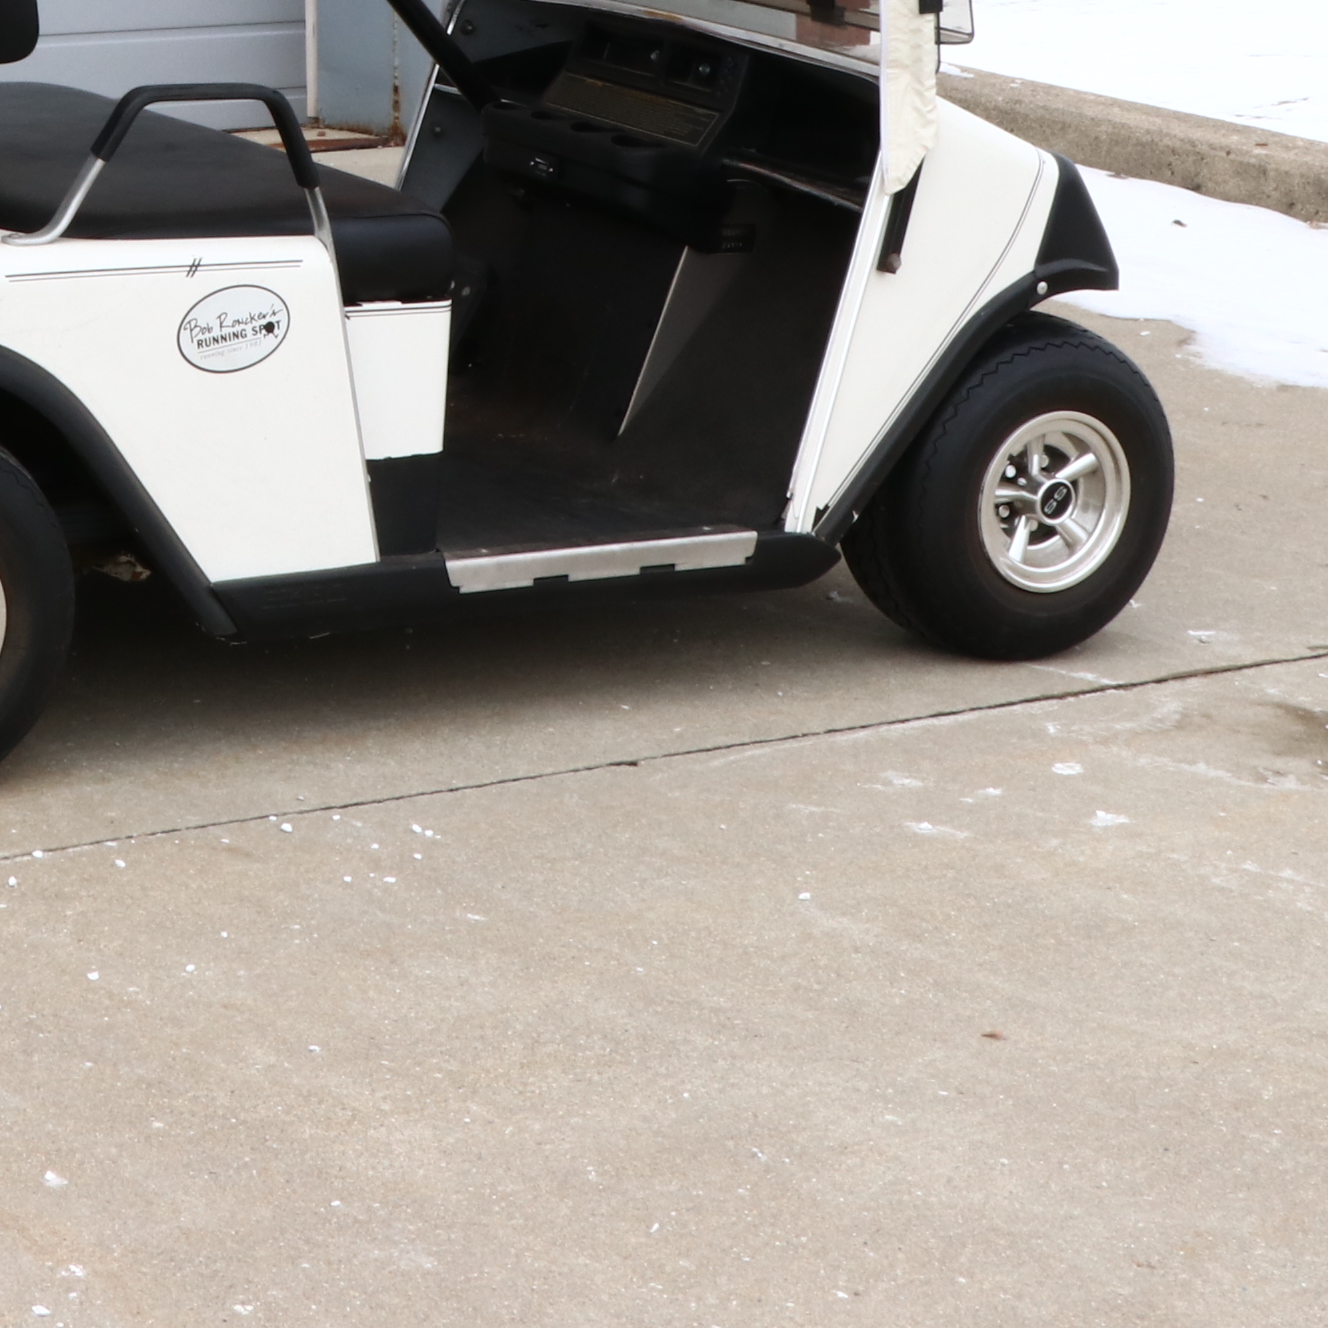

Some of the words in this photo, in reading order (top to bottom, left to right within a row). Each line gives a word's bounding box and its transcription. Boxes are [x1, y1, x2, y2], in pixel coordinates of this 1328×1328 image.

[183, 318, 213, 343] Bob
[197, 329, 247, 349] RUNNING
[1044, 486, 1067, 514] SS
